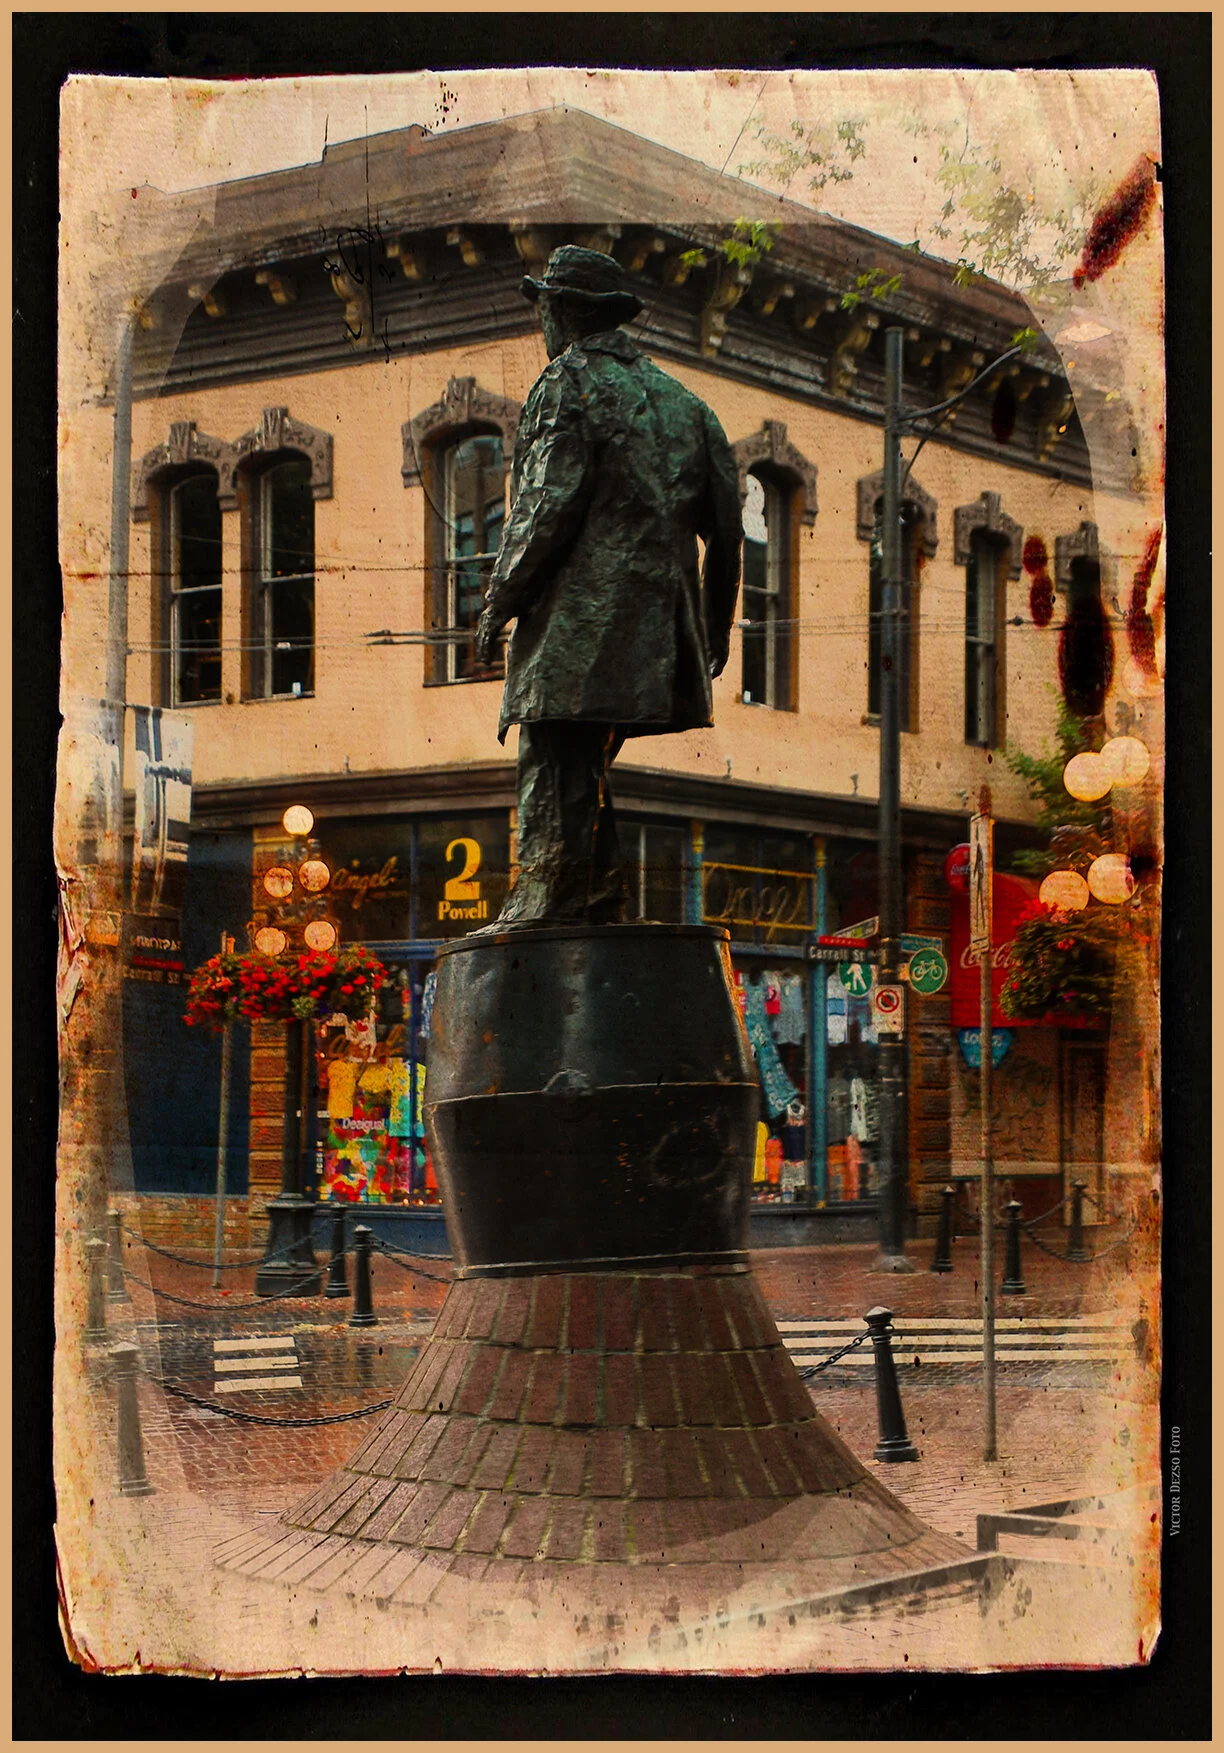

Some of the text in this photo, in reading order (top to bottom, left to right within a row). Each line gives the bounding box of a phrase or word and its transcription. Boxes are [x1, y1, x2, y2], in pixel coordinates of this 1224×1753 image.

[445, 838, 481, 900] 2
[438, 901, 488, 920] Powell
[809, 946, 849, 960] Carrall
[853, 950, 866, 961] St
[341, 1118, 385, 1133] Desigual
